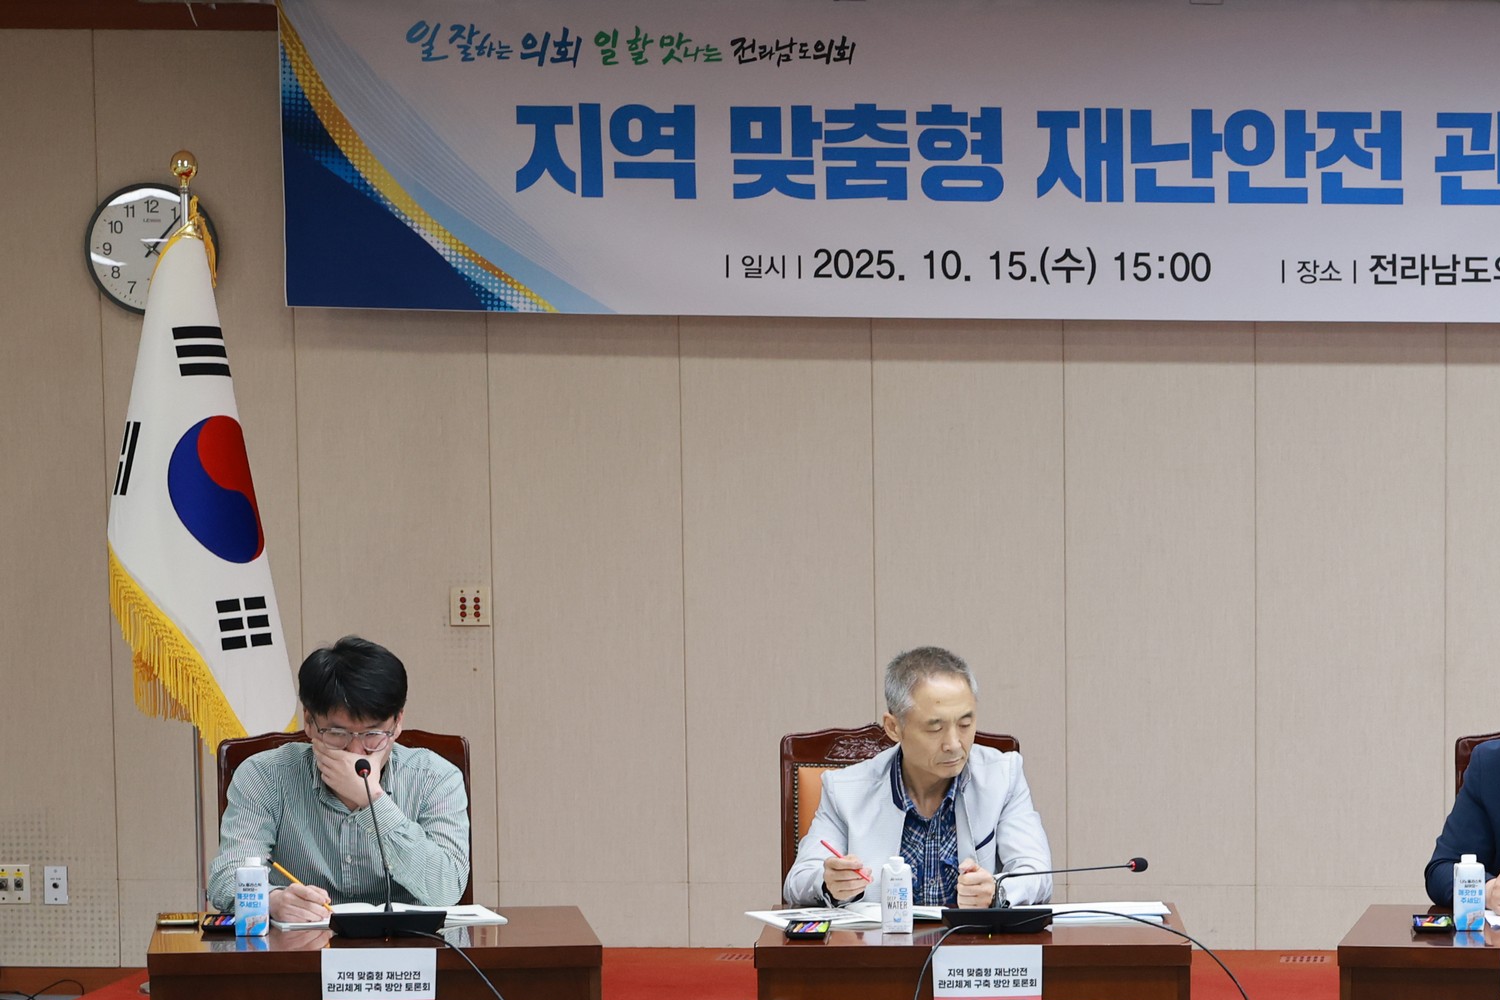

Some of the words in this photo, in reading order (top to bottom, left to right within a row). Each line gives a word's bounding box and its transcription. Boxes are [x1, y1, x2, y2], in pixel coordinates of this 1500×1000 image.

[406, 20, 448, 61] 일
[447, 24, 513, 62] 잘하는
[520, 27, 582, 68] 의회
[594, 28, 619, 65] 일
[626, 25, 654, 65] 할
[660, 32, 722, 65] 맛나는
[730, 35, 856, 67] 전라남도의회
[516, 102, 696, 199] 지역
[730, 103, 1005, 203] 맞춤형
[1036, 107, 1403, 205] 재난안전
[124, 205, 134, 218] 11
[144, 200, 159, 213] 12
[108, 220, 123, 234] 10
[103, 242, 112, 255] 9
[111, 265, 120, 279] 8
[742, 255, 785, 279] 일시
[814, 249, 904, 281] 2025.
[924, 250, 970, 281] 10.
[990, 247, 1096, 285] 15.(수)
[1114, 252, 1211, 282] 15:00
[1297, 260, 1342, 284] 장소
[128, 281, 136, 294] 7
[888, 901, 907, 909] WATER
[338, 972, 354, 980] 지역
[358, 971, 383, 980] 맞춤형
[386, 971, 420, 980] 재난안전
[948, 969, 964, 977] 지역
[967, 968, 991, 976] 맞춤형
[995, 968, 1027, 976] 재난안전
[328, 983, 362, 992] 관리체계
[365, 983, 382, 992] 구축
[385, 983, 402, 992] 방안
[405, 983, 430, 991] 토론회
[938, 980, 971, 988] 관리체계
[975, 979, 990, 988] 구축
[994, 979, 1010, 988] 방안
[1013, 979, 1036, 987] 토론회
